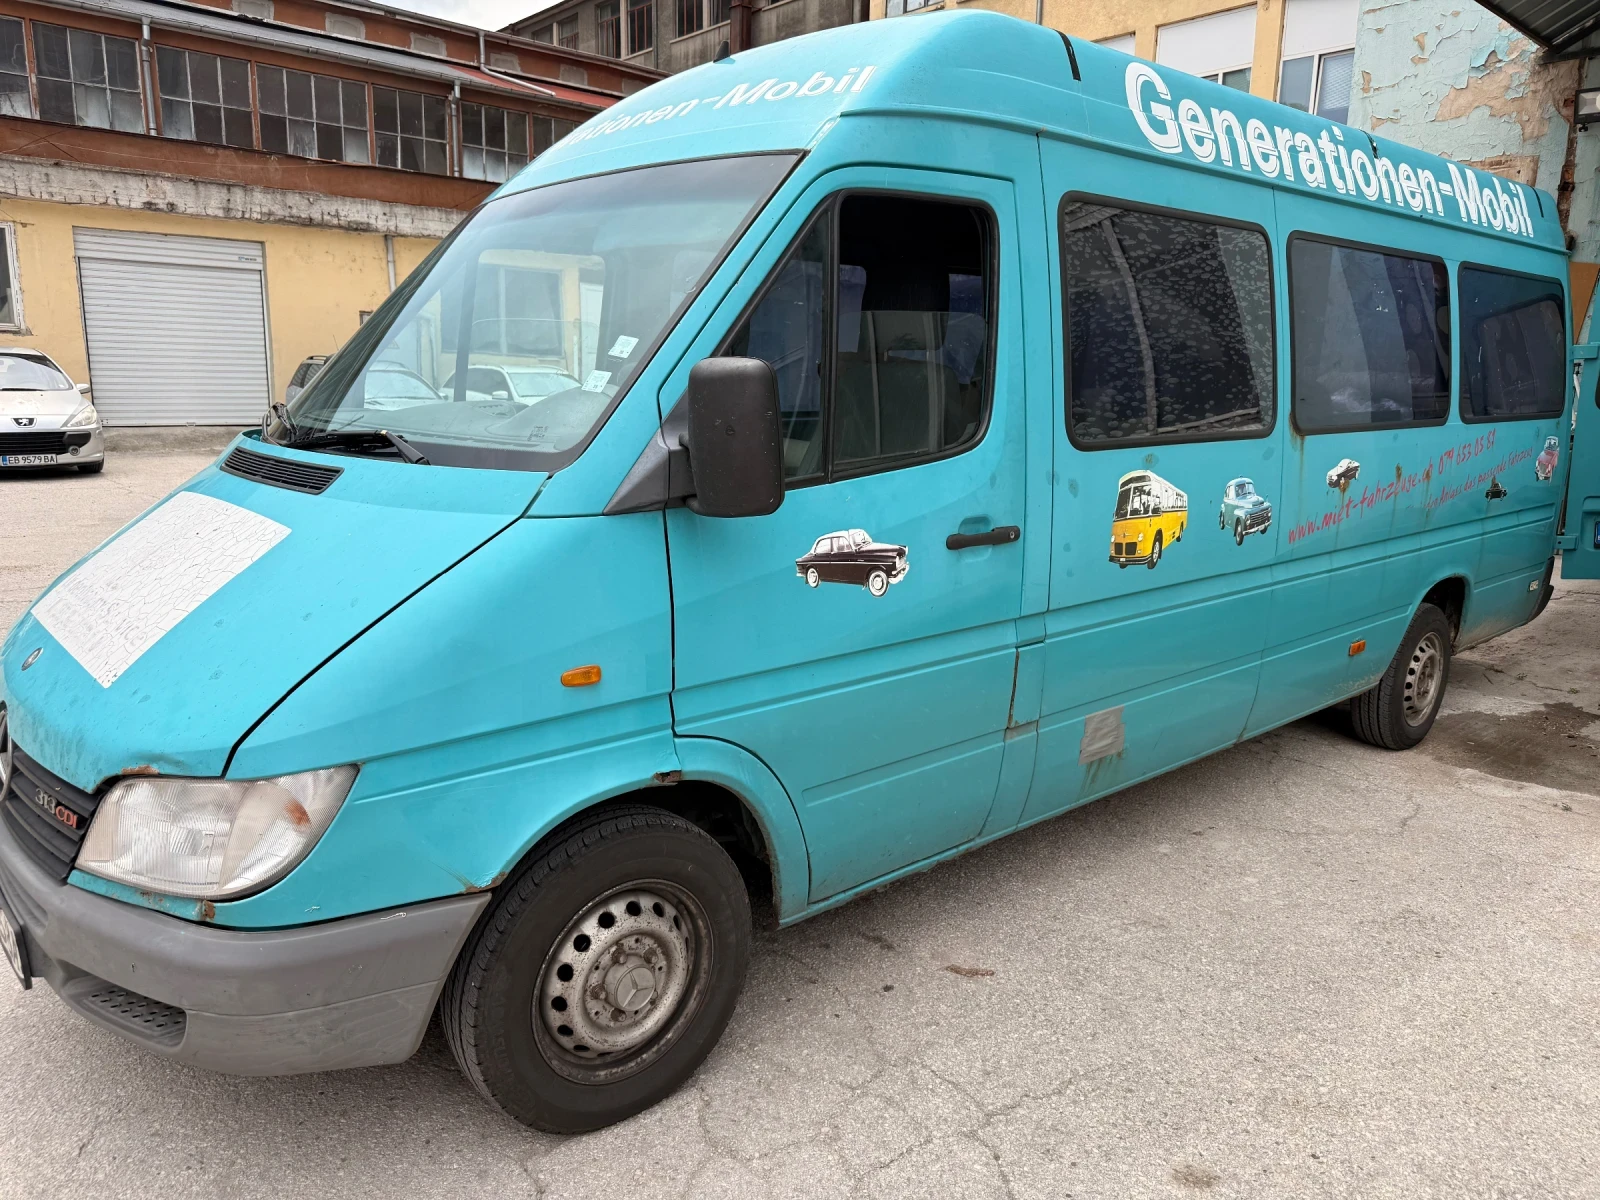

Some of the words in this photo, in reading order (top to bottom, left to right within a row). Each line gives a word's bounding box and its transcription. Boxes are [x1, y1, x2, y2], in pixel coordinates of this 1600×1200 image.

[1125, 62, 1534, 237] Generationen-Mobil
[8, 456, 20, 464] EB
[21, 455, 42, 464] 9579
[43, 455, 55, 463] BA
